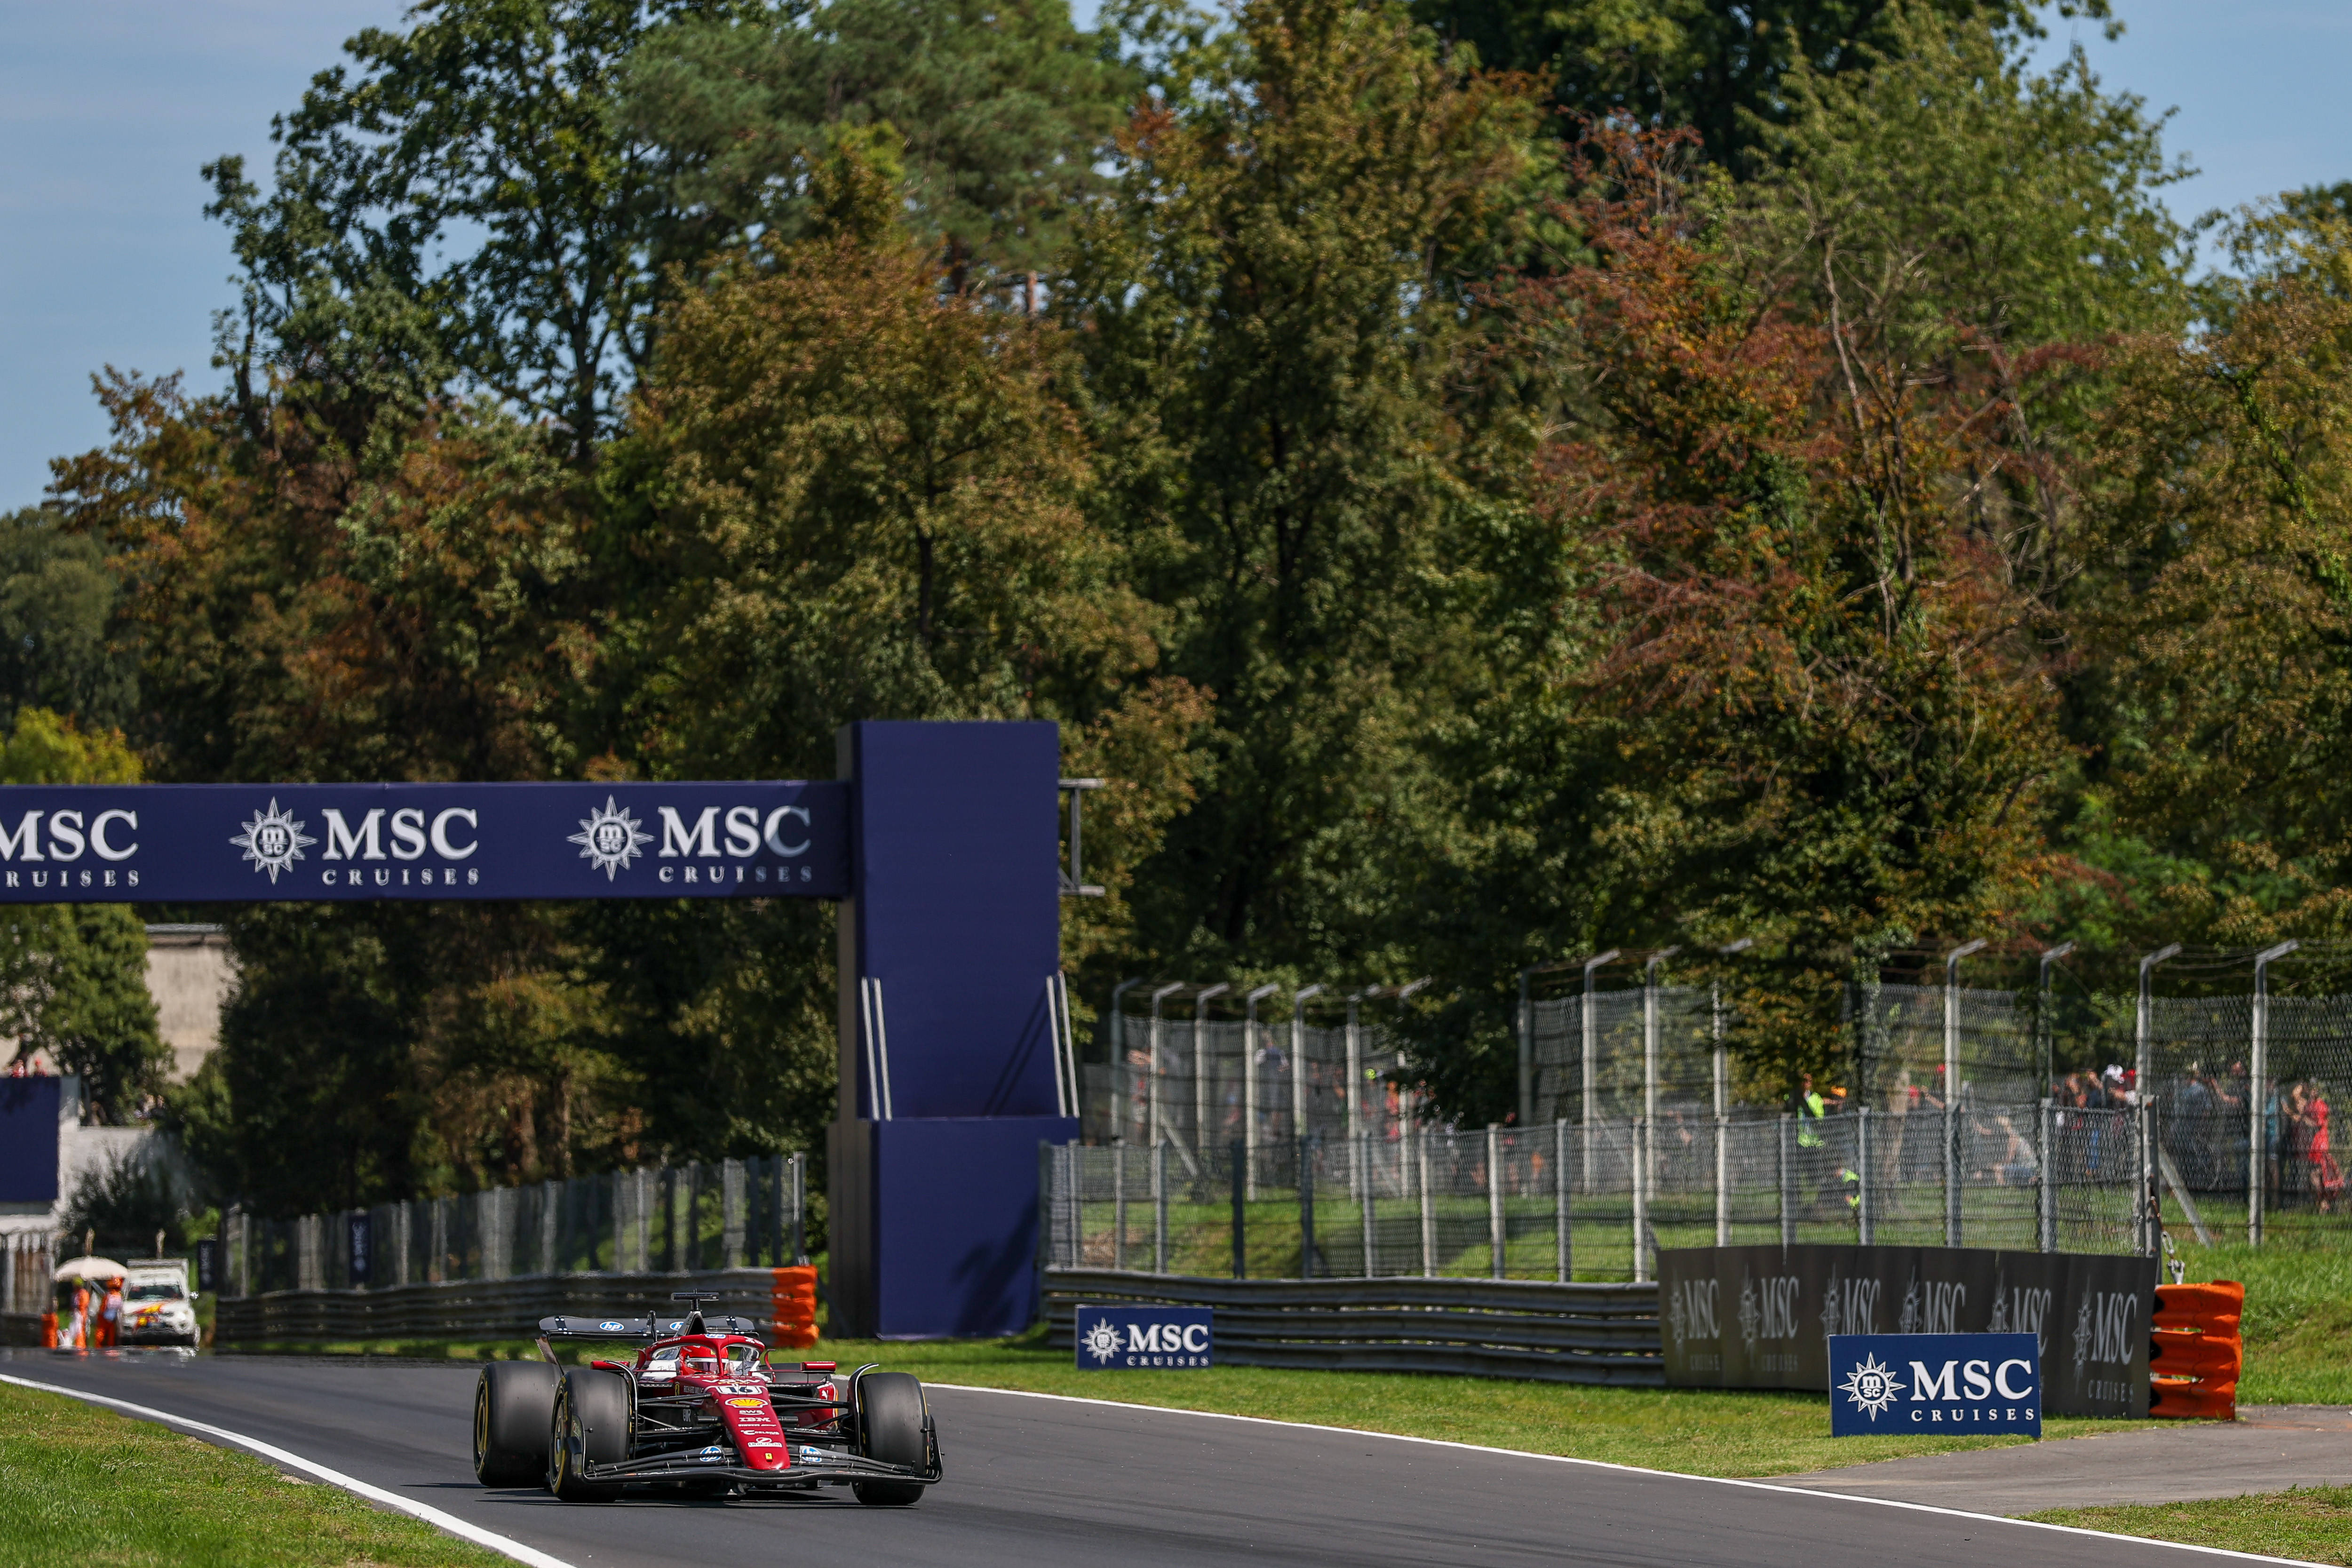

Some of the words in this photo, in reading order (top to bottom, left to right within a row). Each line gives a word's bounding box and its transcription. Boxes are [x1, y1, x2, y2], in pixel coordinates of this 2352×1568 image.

[0, 809, 138, 861] MSC
[322, 808, 478, 860] MSC
[658, 806, 810, 858] MSC
[6, 870, 140, 887] RUISES
[322, 868, 479, 885] CRUISES
[659, 866, 811, 883] CRUISES
[602, 1321, 622, 1331] hp
[1685, 1278, 1721, 1339] MSC
[1761, 1276, 1799, 1339] MSC
[1841, 1277, 1880, 1335] MSC
[1923, 1281, 1966, 1333] MSC
[2012, 1286, 2051, 1357] MSC
[1126, 1323, 1209, 1353] MSC
[2090, 1291, 2138, 1365] MSC
[1126, 1355, 1209, 1367] CRUISES
[1908, 1359, 2034, 1401] MSC
[2088, 1380, 2134, 1403] CRUISES
[1910, 1408, 2035, 1422] CRUISES
[701, 1446, 721, 1462] hp
